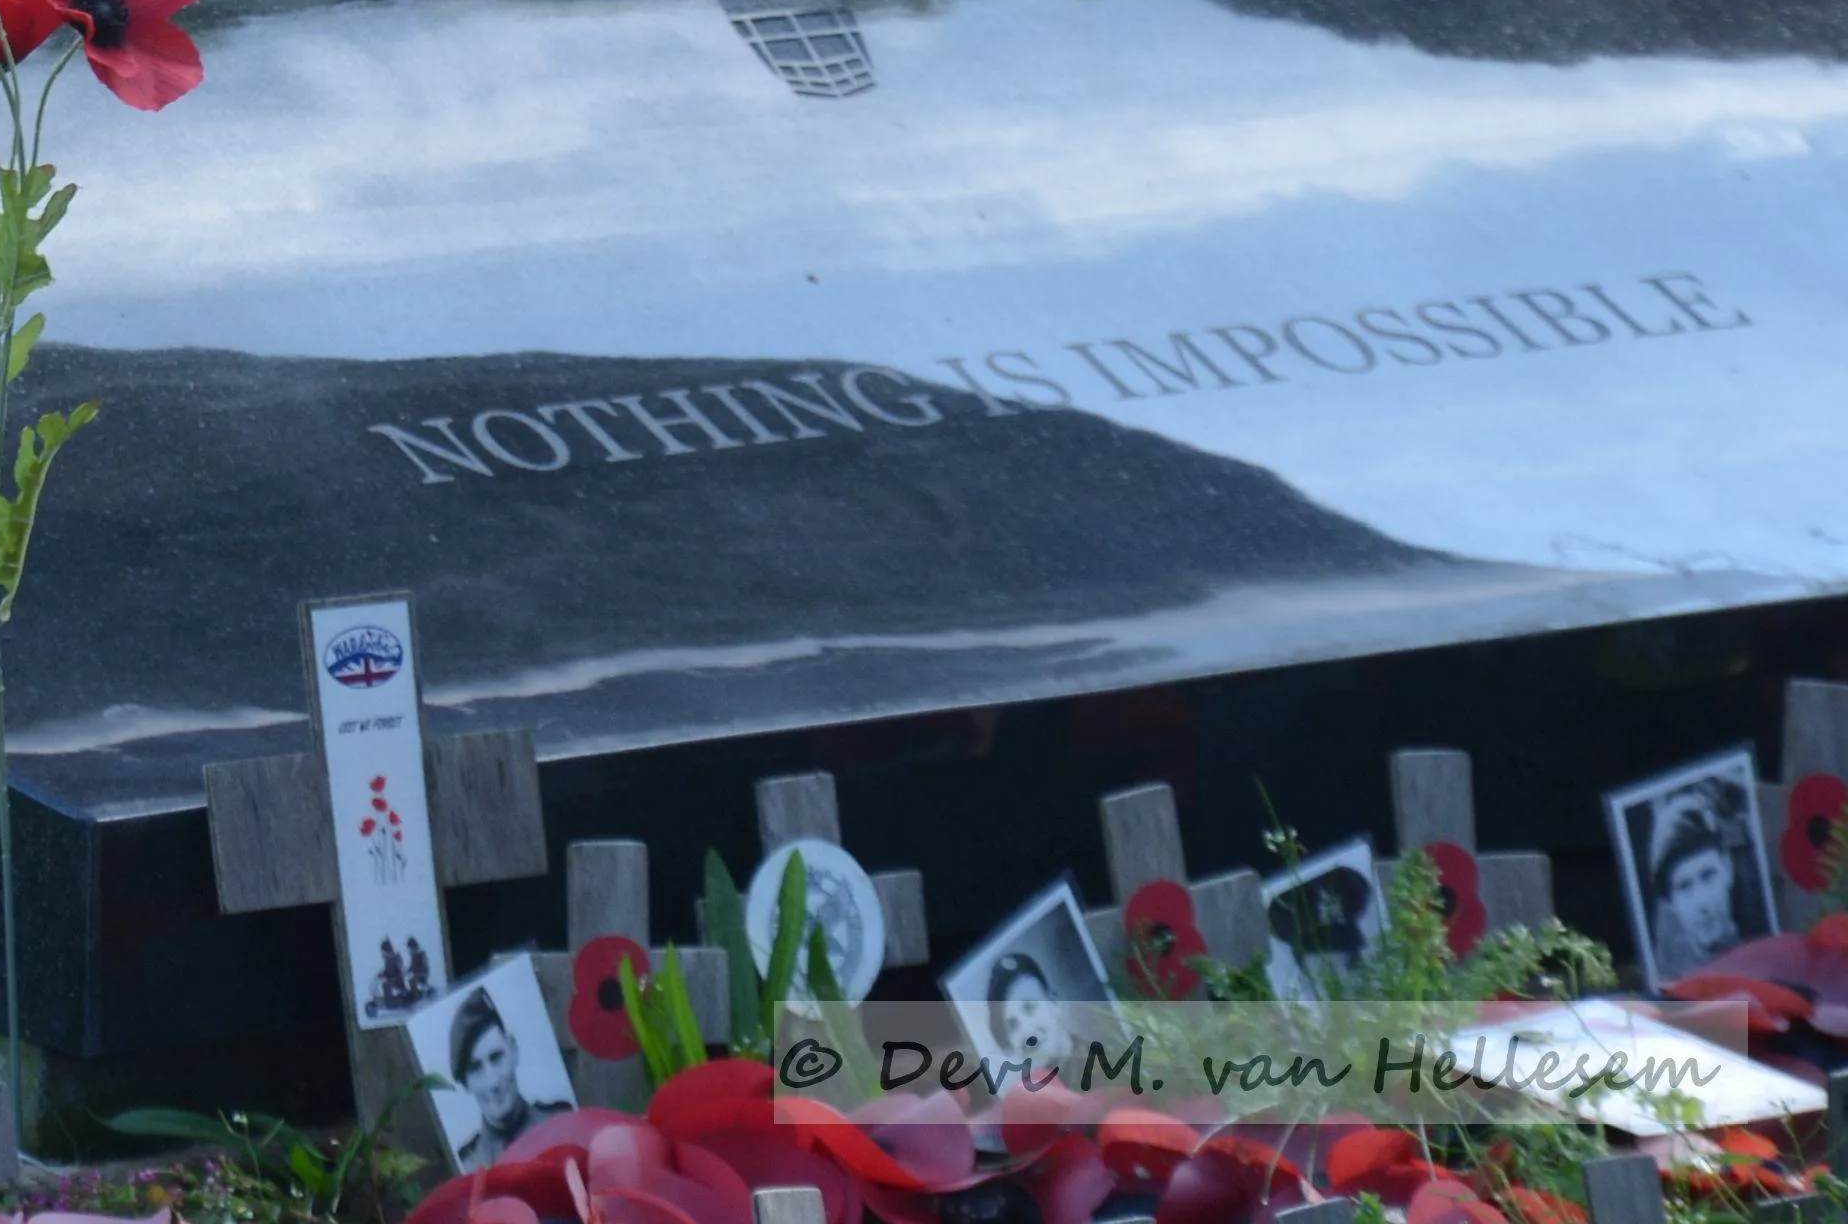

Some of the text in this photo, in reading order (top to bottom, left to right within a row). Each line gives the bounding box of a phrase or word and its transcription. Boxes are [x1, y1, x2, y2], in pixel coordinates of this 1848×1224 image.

[368, 270, 1754, 485] NOTHING IS IMPOSSIBLE
